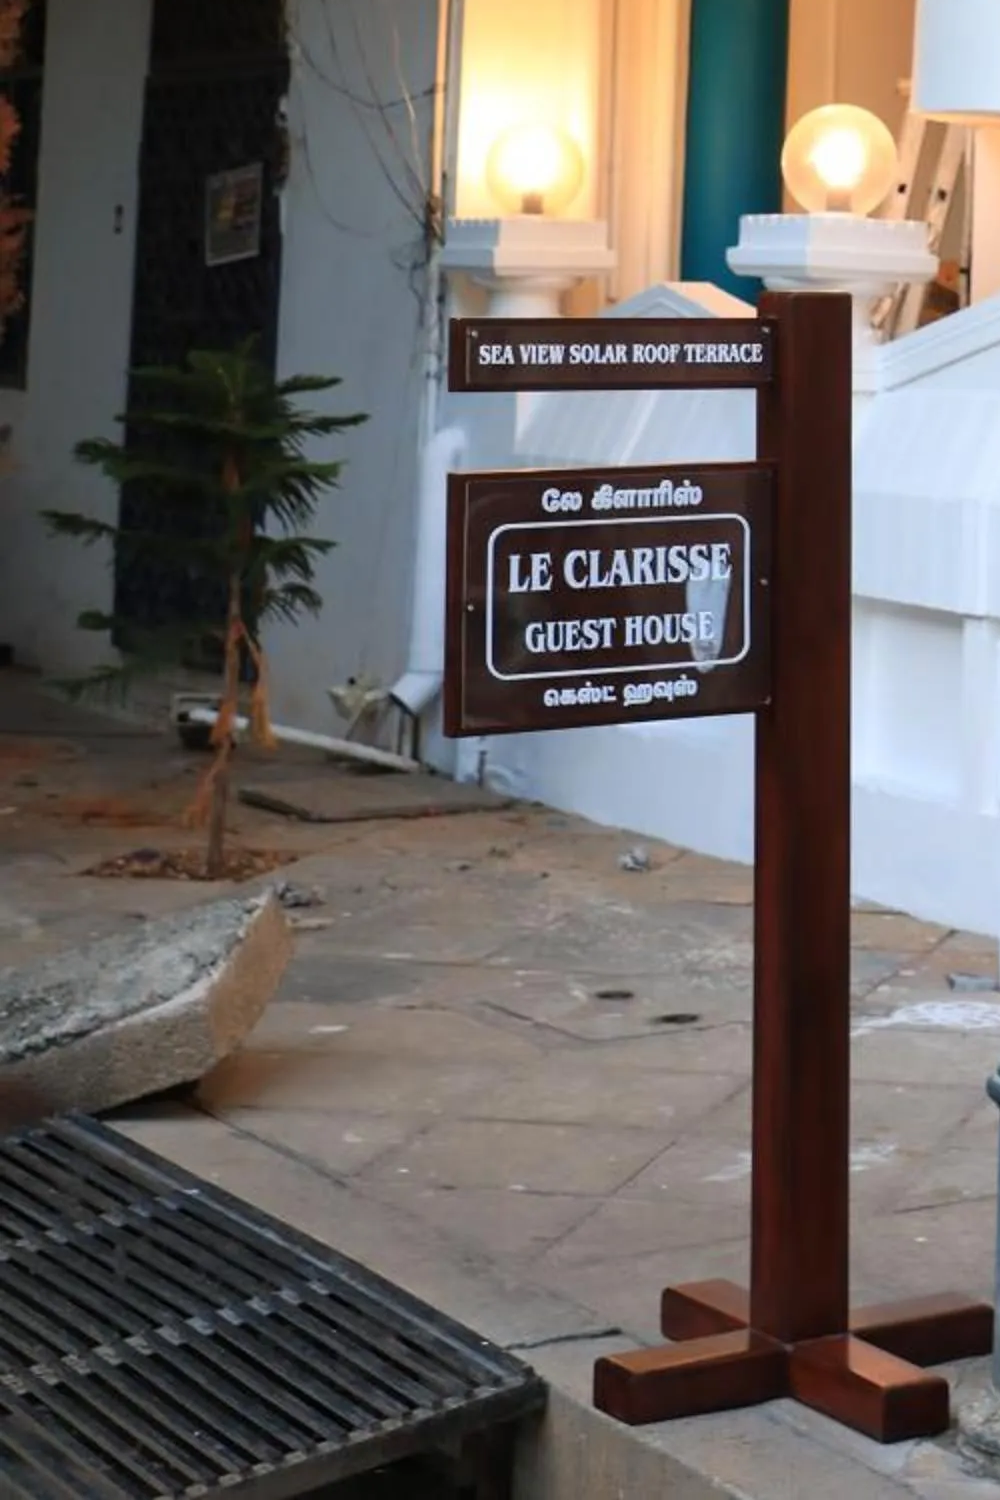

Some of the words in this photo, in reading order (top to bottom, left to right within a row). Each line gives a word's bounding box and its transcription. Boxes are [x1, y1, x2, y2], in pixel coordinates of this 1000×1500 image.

[479, 344, 515, 365] SEA
[519, 344, 565, 365] VIEW
[569, 343, 627, 365] SOLAR
[632, 343, 681, 363] ROOF
[684, 343, 763, 364] TERRACE
[508, 553, 553, 593] LE
[563, 543, 732, 590] CLARISSE
[525, 617, 617, 653] GUEST
[624, 611, 716, 647] HOUSE
